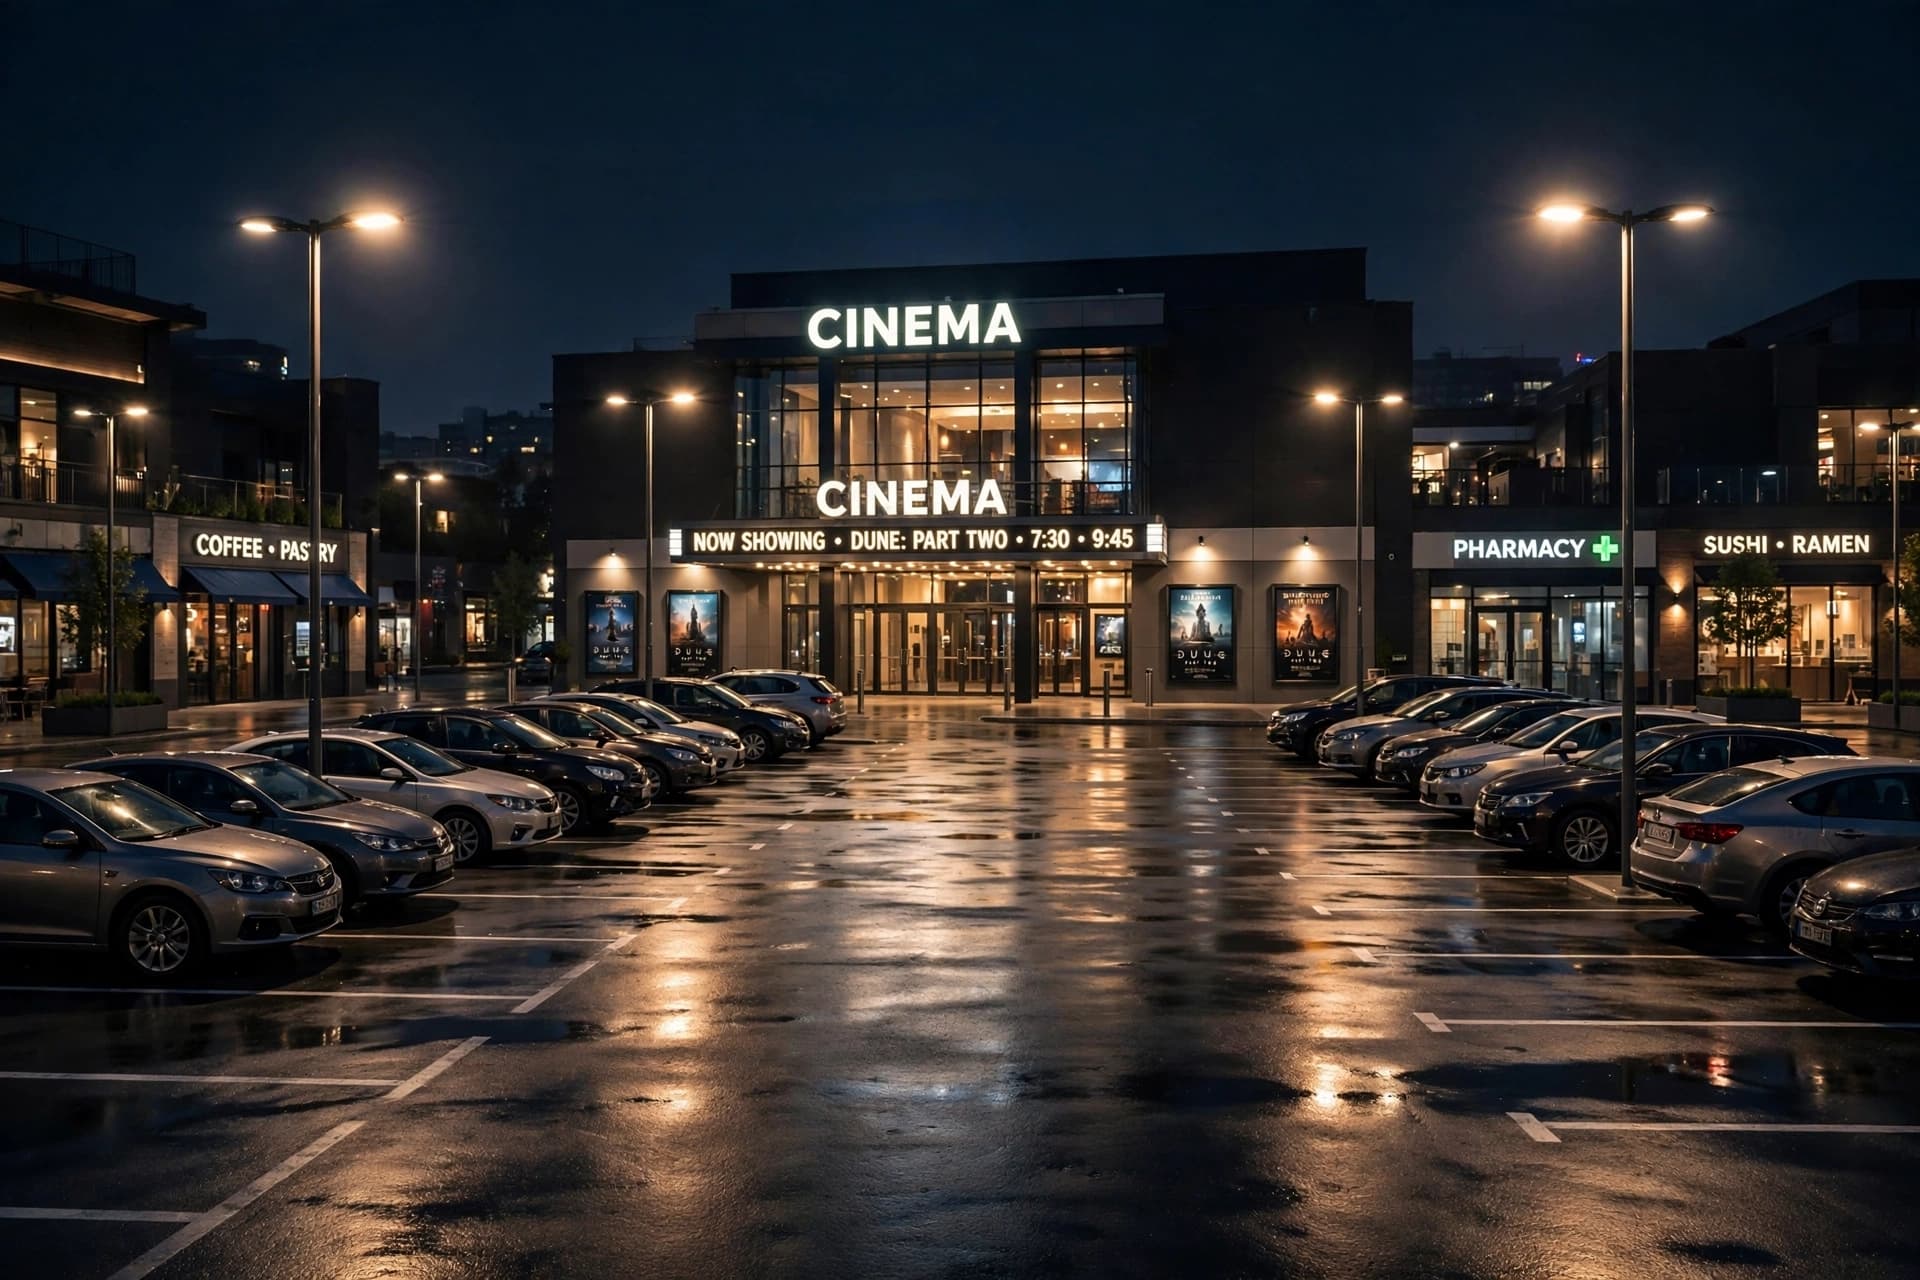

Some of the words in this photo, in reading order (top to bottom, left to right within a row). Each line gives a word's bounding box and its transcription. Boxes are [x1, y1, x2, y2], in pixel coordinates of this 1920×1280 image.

[807, 302, 1022, 349] CINEMA
[816, 478, 1008, 517] CINEMA
[196, 533, 263, 559] COFFEE
[280, 540, 337, 563] PASRY
[692, 531, 735, 552] NOW
[741, 531, 825, 552] SHOWING
[851, 530, 906, 550] DUNE:
[913, 530, 959, 550] PART
[965, 529, 1008, 549] TWO
[1031, 529, 1070, 549] 7:30
[1092, 528, 1133, 548] 9:45
[1453, 538, 1586, 559] PHARMACY
[1704, 535, 1768, 554] SUSHI
[1792, 534, 1869, 554] RAMEN
